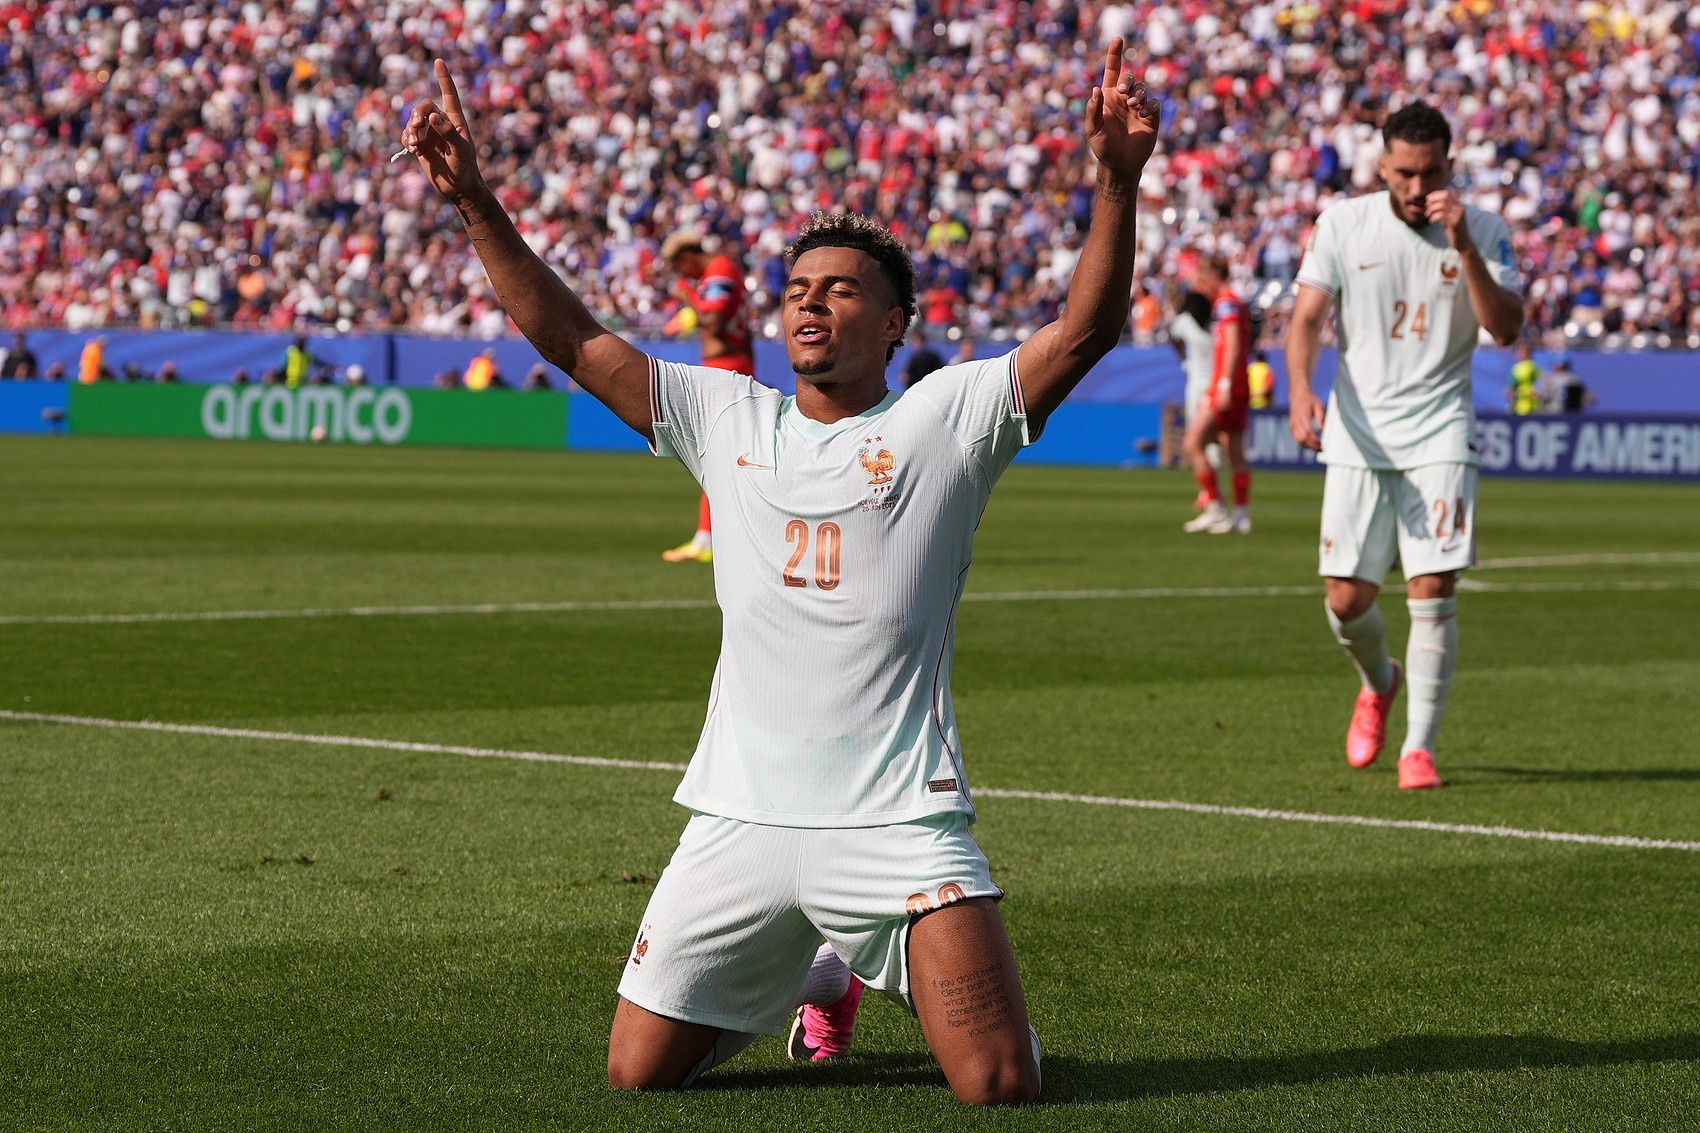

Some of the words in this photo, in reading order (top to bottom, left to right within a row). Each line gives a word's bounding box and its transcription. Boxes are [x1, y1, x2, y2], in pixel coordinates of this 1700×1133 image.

[1390, 300, 1428, 341] 24
[202, 384, 412, 444] aramco
[1515, 419, 1570, 472] OF
[1432, 497, 1467, 539] 24
[782, 519, 841, 591] 20
[941, 986, 964, 998] clear
